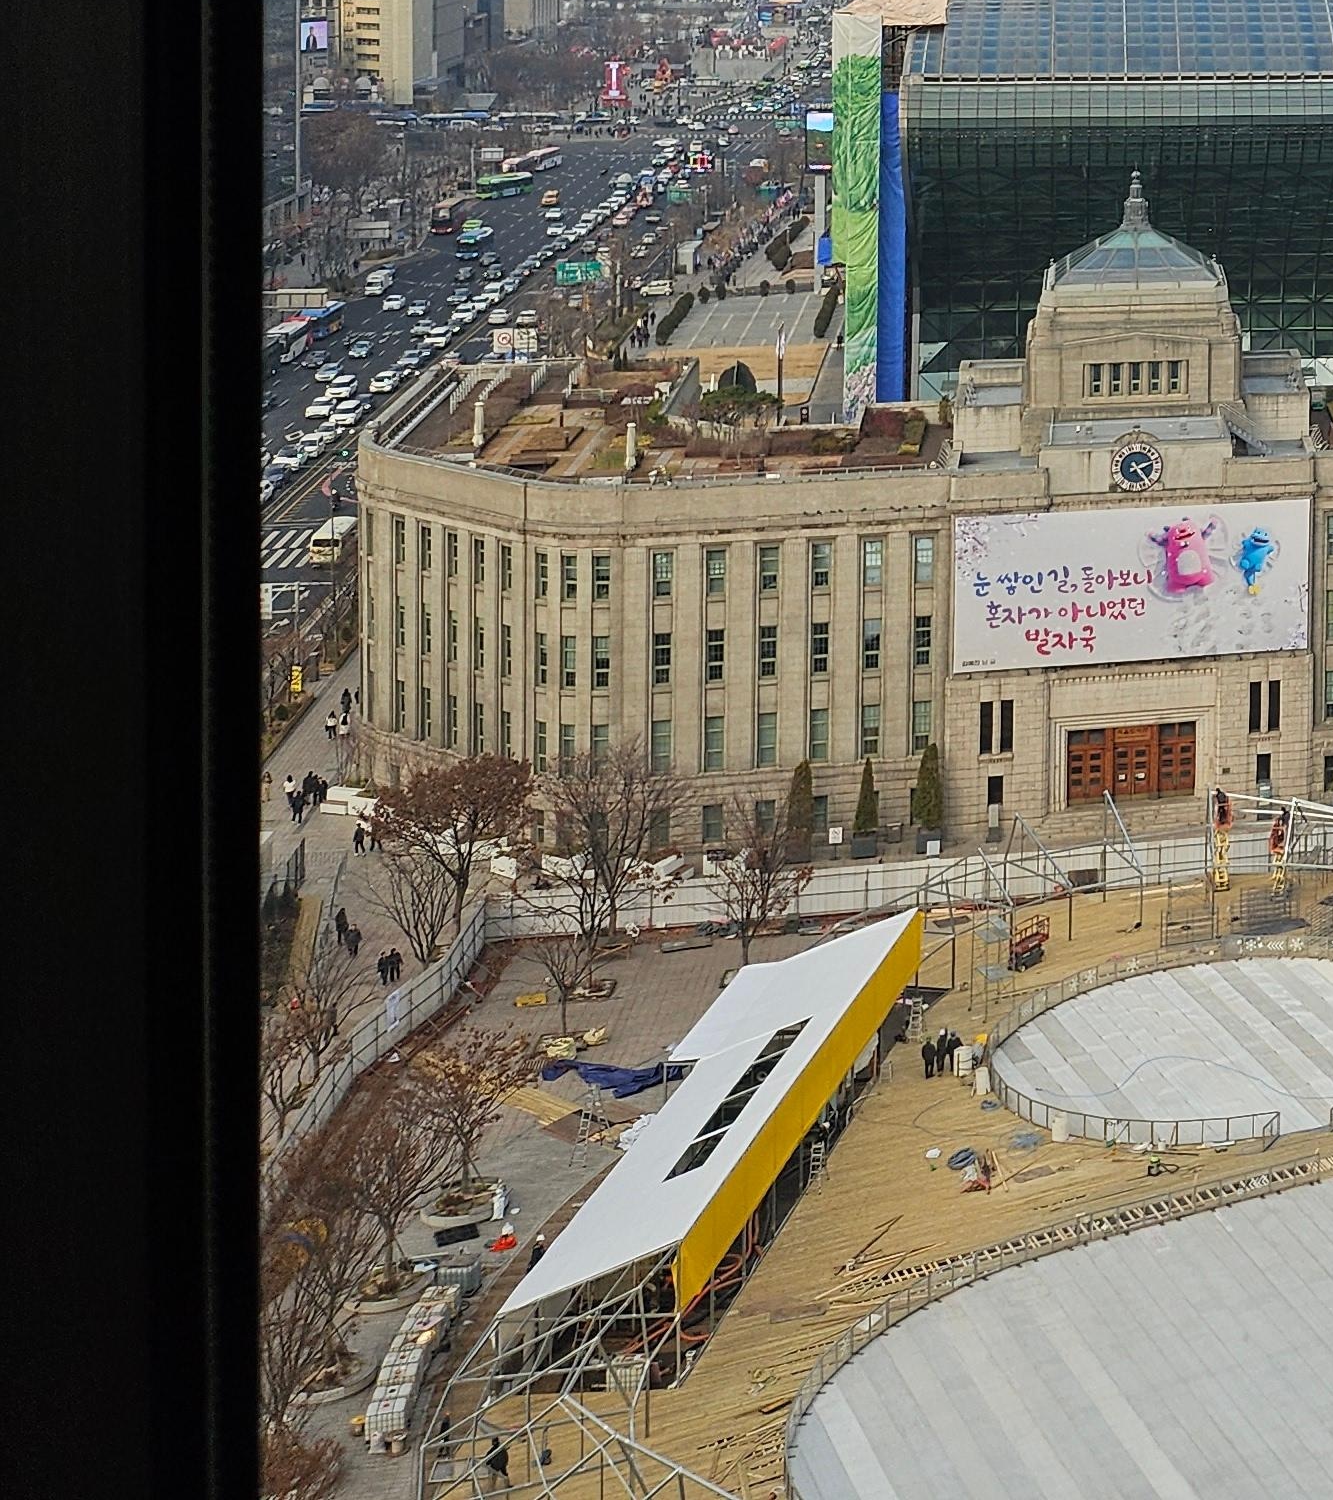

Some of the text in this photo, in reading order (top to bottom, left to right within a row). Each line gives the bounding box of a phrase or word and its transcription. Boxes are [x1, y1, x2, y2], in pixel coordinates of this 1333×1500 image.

[973, 571, 992, 597] 눈
[996, 570, 1044, 596] 쌓인
[1081, 566, 1153, 594] 돌아보니
[986, 596, 1146, 629] 혼자가 아니었던
[1024, 625, 1097, 656] 발자국
